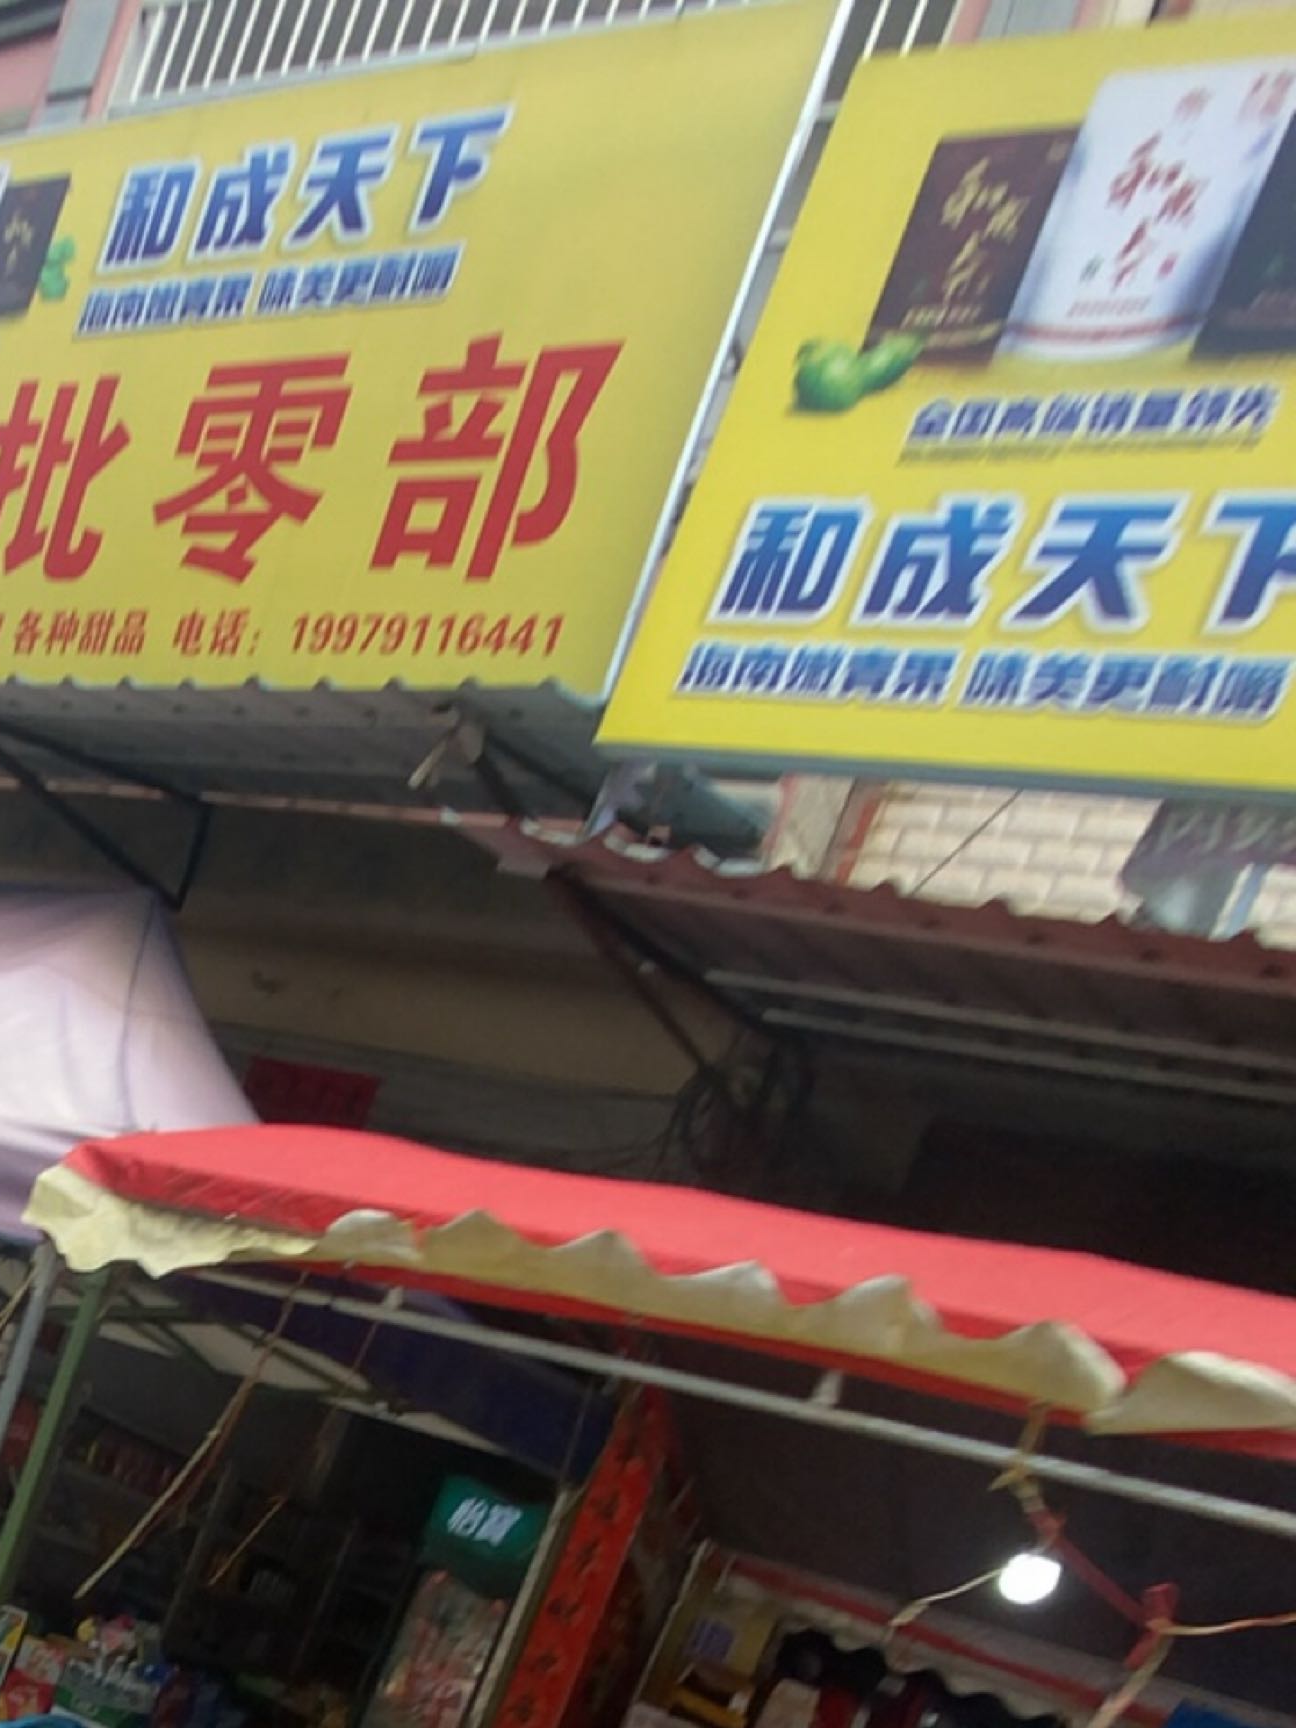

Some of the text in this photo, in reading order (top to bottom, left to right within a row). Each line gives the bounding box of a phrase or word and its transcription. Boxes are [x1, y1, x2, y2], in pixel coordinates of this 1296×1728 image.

[100, 107, 511, 269] 和成天下
[707, 491, 1296, 629] 和成天下
[11, 607, 149, 657] 各种甜品
[289, 610, 565, 658] 19979116441
